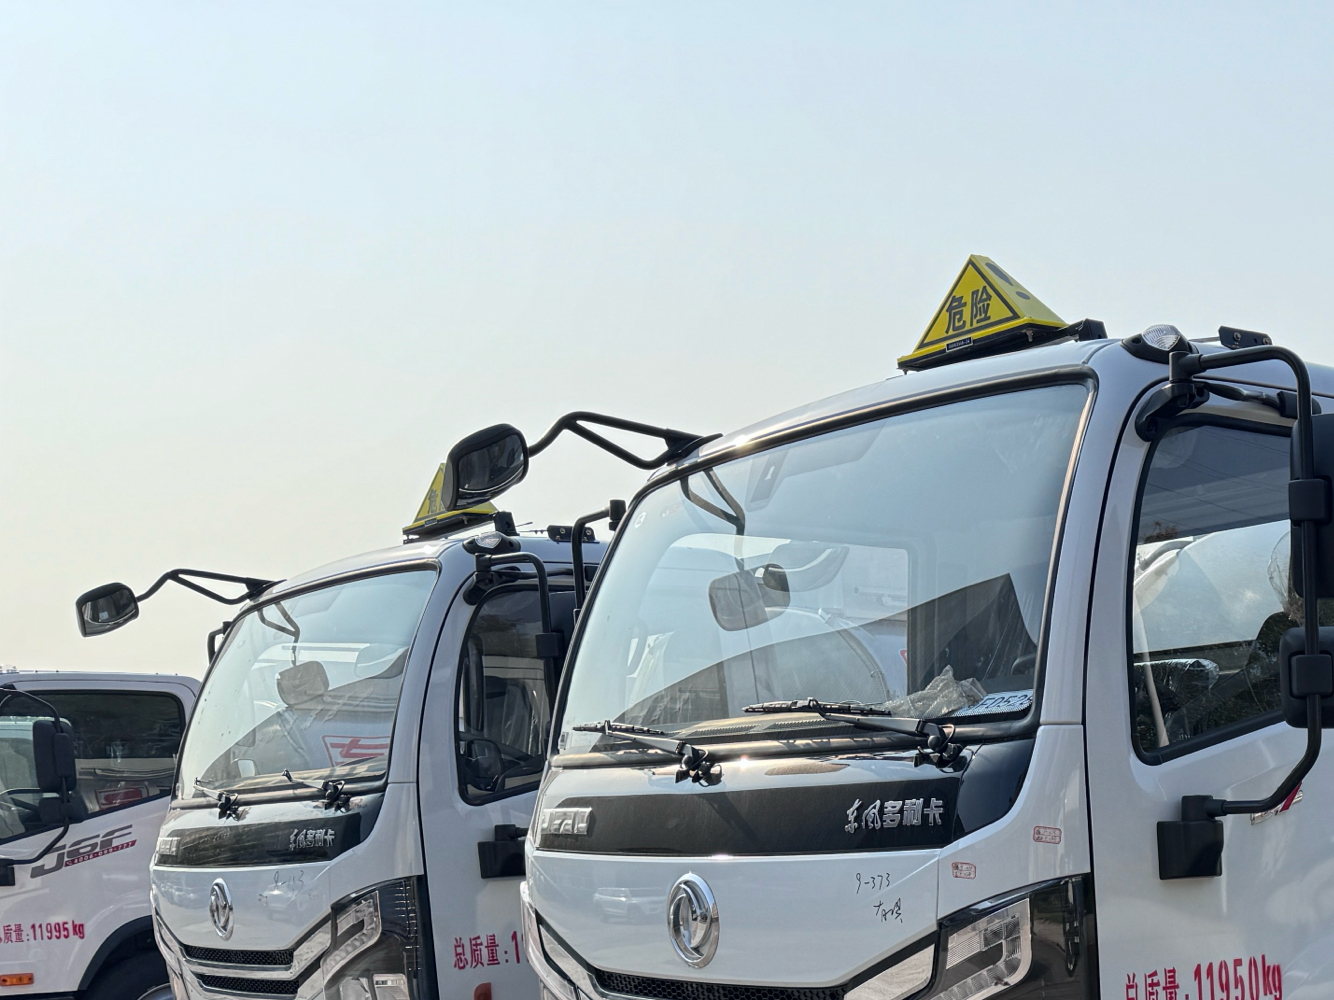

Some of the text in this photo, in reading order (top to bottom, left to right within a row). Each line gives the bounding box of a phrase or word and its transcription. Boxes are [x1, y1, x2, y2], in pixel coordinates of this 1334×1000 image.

[945, 285, 992, 334] 危险
[844, 798, 944, 834] 东风多利卡
[0, 920, 85, 944] 质量:11995kg
[453, 931, 530, 970] 总质量:1
